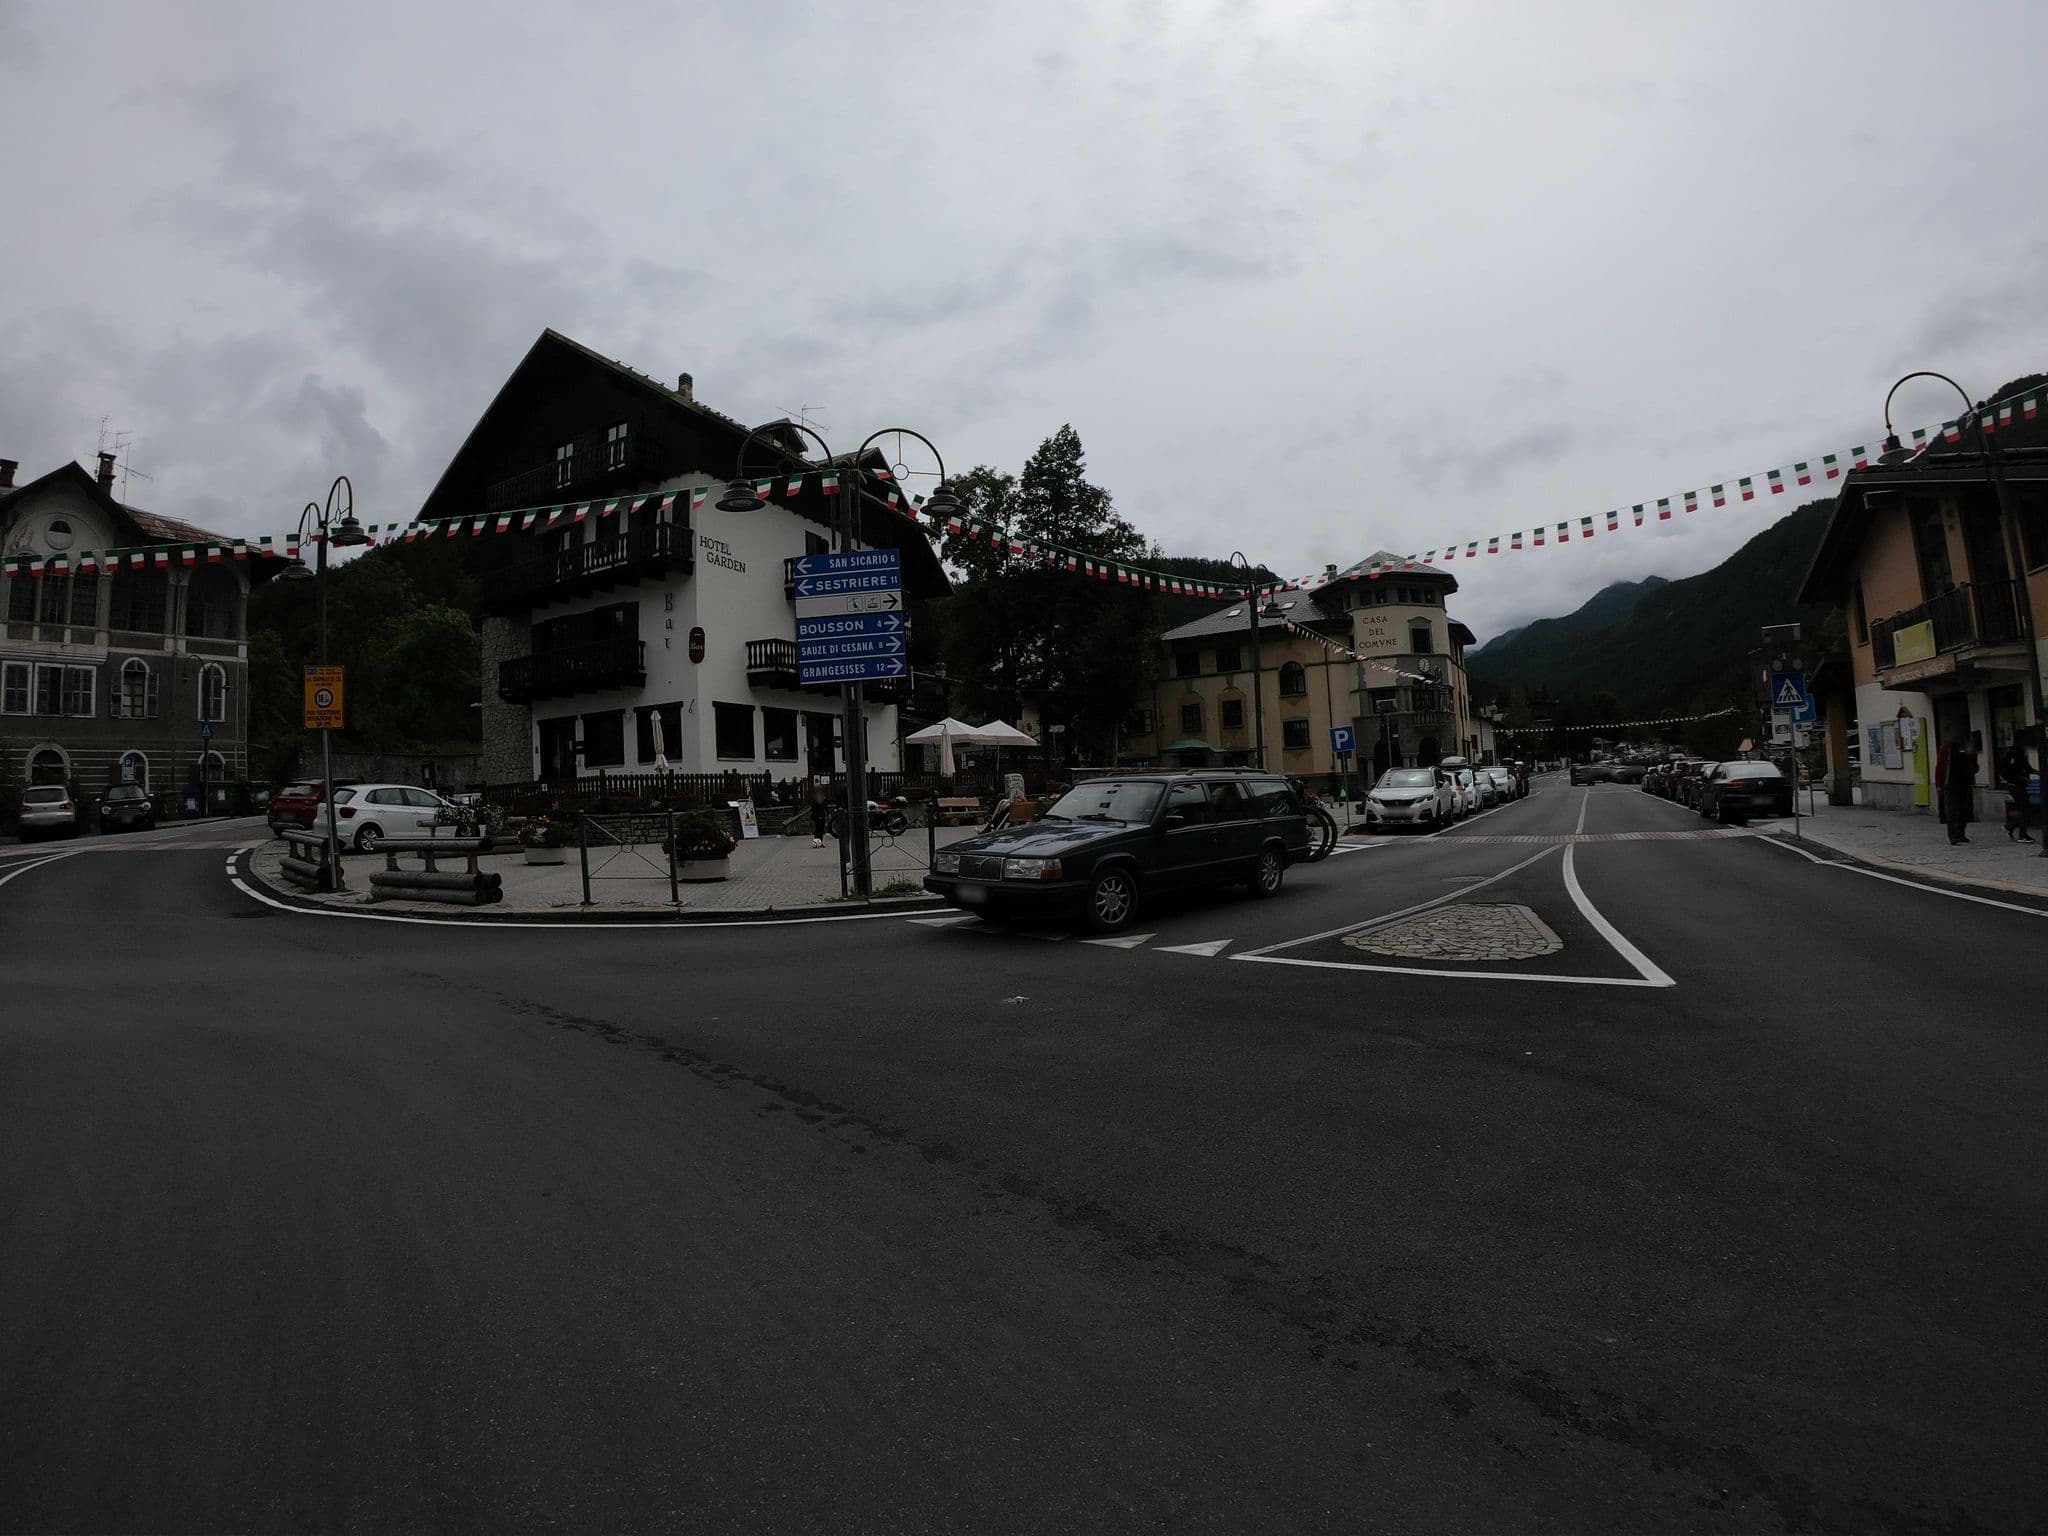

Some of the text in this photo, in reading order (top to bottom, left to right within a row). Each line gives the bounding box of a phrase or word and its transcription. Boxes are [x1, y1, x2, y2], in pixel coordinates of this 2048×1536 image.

[699, 535, 732, 556] HOTEL
[706, 551, 747, 574] GARDEN
[829, 554, 896, 569] SAN SICARIO 6
[815, 575, 898, 591] SESTRIERE 11
[799, 620, 882, 635] BOUSSON 4
[1362, 615, 1388, 625] CASA
[1369, 628, 1385, 636] DEL
[801, 644, 827, 656] SAUZE
[829, 644, 839, 654] DI
[841, 641, 874, 653] CESANA
[802, 663, 885, 678] GRANGESISES 12
[1334, 730, 1349, 749] P
